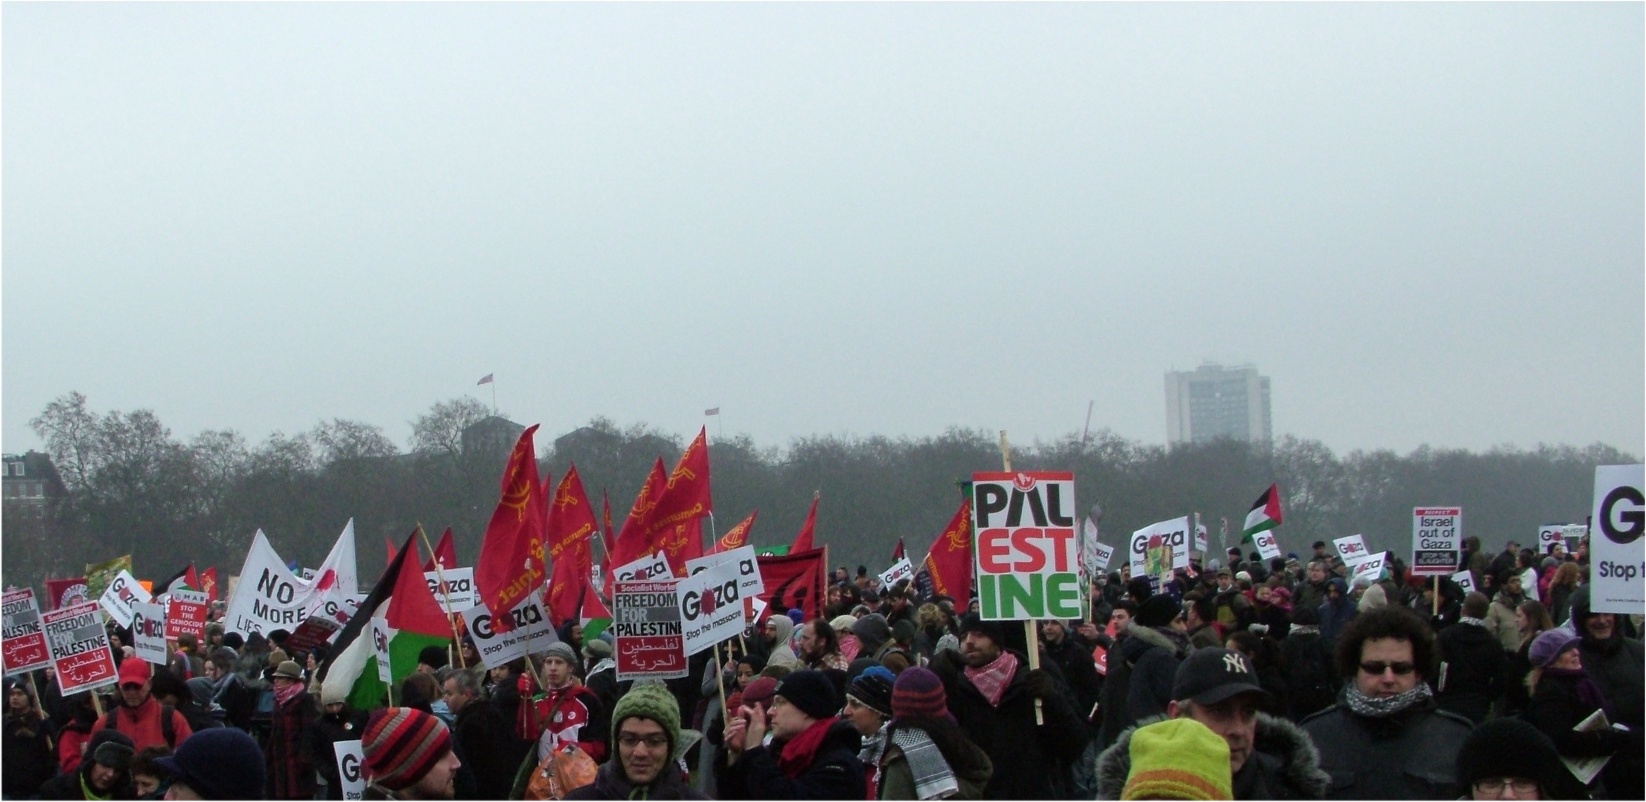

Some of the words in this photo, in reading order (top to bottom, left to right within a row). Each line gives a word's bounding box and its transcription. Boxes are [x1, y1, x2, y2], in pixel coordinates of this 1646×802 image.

[975, 483, 1073, 528] PAL
[1421, 516, 1454, 527] Israel
[1418, 528, 1438, 538] out
[1442, 527, 1456, 538] of
[978, 527, 1074, 574] EST
[1421, 539, 1452, 549] Gaza
[1600, 561, 1637, 582] Stop
[257, 567, 295, 604] NO
[621, 584, 652, 592] Socialist
[615, 592, 678, 608] FREEDOM
[979, 573, 1080, 619] INE
[253, 598, 306, 624] MORE
[621, 608, 648, 623] FOR
[45, 613, 96, 636] FREEDOM
[170, 618, 203, 628] GENOCIDE
[181, 627, 200, 635] GAZA
[236, 614, 263, 635] LIES
[686, 628, 701, 641] Stop
[701, 621, 712, 633] the
[712, 610, 742, 628] massacre
[53, 634, 108, 660] PALESTINE
[54, 631, 75, 647] FOR
[483, 644, 503, 656] Stop
[502, 638, 516, 648] the
[622, 637, 679, 655] لفلسطين
[62, 650, 106, 674] لفلسطين
[631, 654, 676, 671] الحرية
[1222, 653, 1248, 674] NY
[71, 664, 107, 684] الحرية
